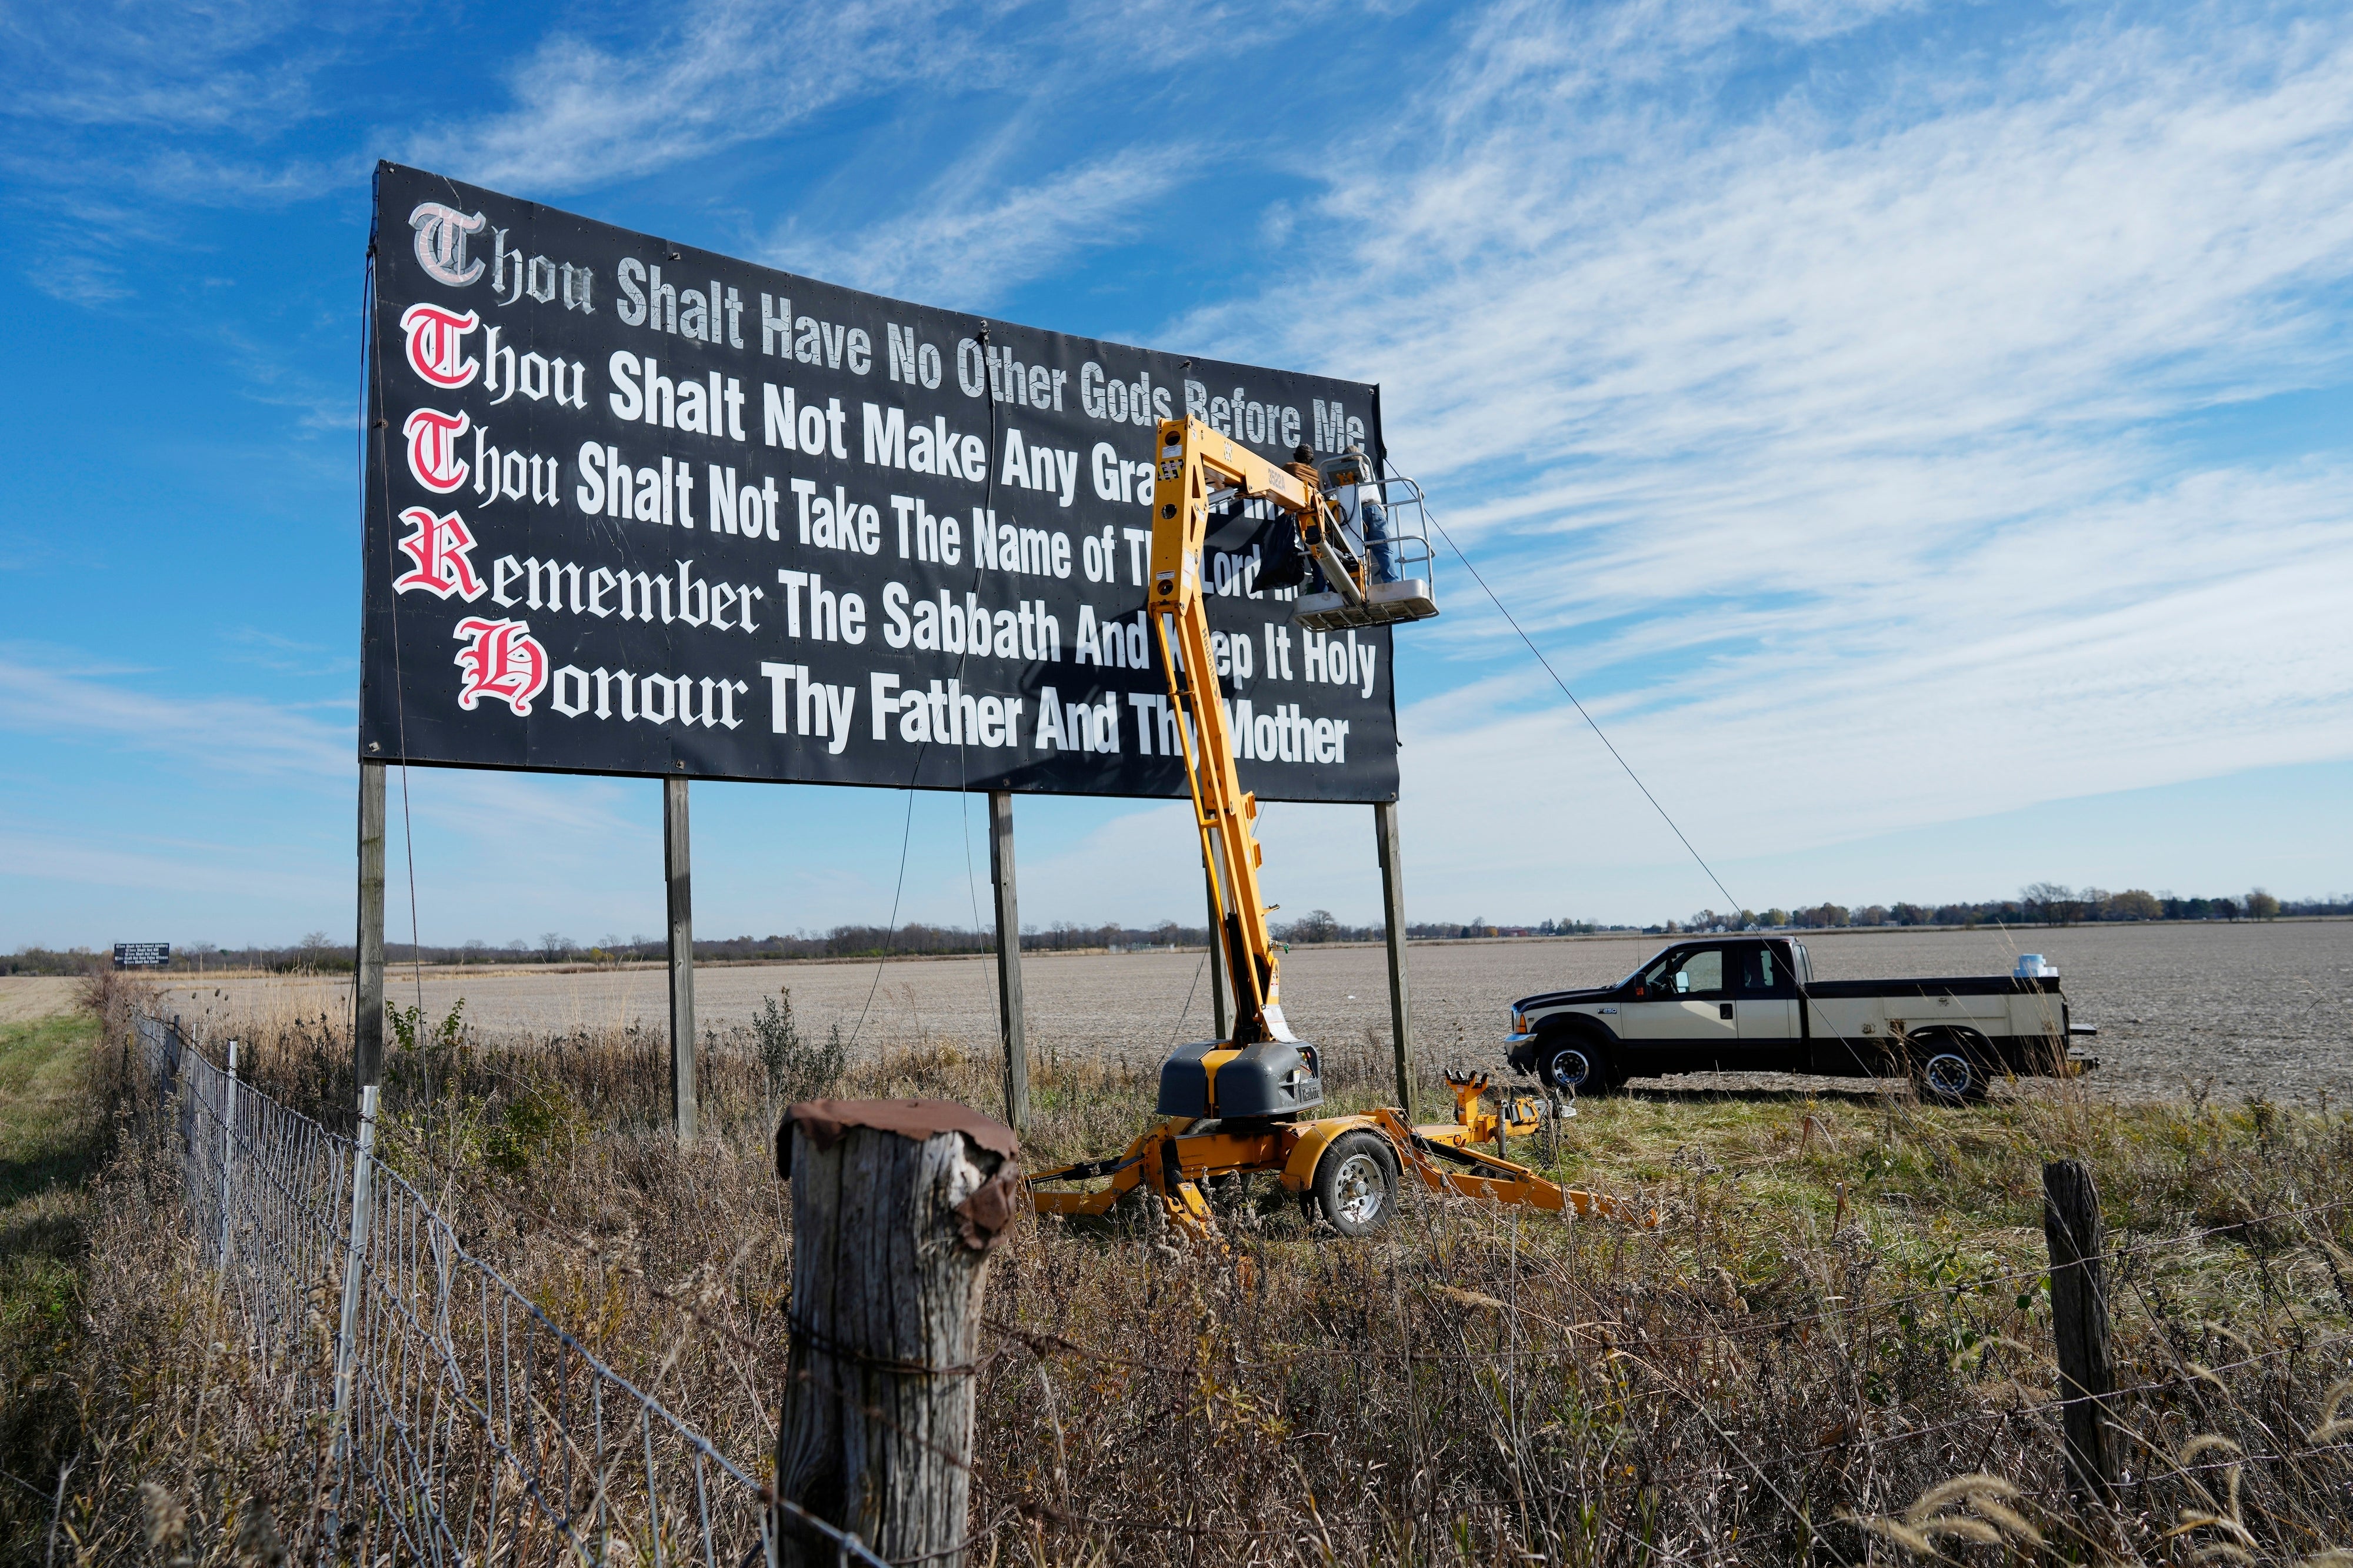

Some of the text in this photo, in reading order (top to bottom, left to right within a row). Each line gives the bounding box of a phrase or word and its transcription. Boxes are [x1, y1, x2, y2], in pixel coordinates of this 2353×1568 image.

[399, 303, 588, 409] Thou
[609, 351, 745, 441] Shalt
[764, 382, 847, 459] Not
[863, 402, 986, 482] Make
[1001, 428, 1078, 507] Any
[408, 202, 1365, 454] Thou Shalt Have No Other Gods Before Me
[402, 408, 559, 508] Thou
[576, 441, 694, 528] Shalt
[709, 465, 779, 541] Not
[791, 478, 880, 555] Take
[891, 495, 960, 566] The
[973, 507, 1071, 579] Name
[1083, 525, 1116, 583] of
[1268, 468, 1286, 492] 3522A
[392, 506, 1376, 699] Remember The Sabbath And Kep It Holy
[453, 617, 748, 730] Honour
[761, 662, 855, 755] Thy
[870, 672, 1022, 748] Father
[1035, 686, 1119, 753] And
[1222, 698, 1349, 763] Mother
[1202, 628, 1216, 685] Haulotte
